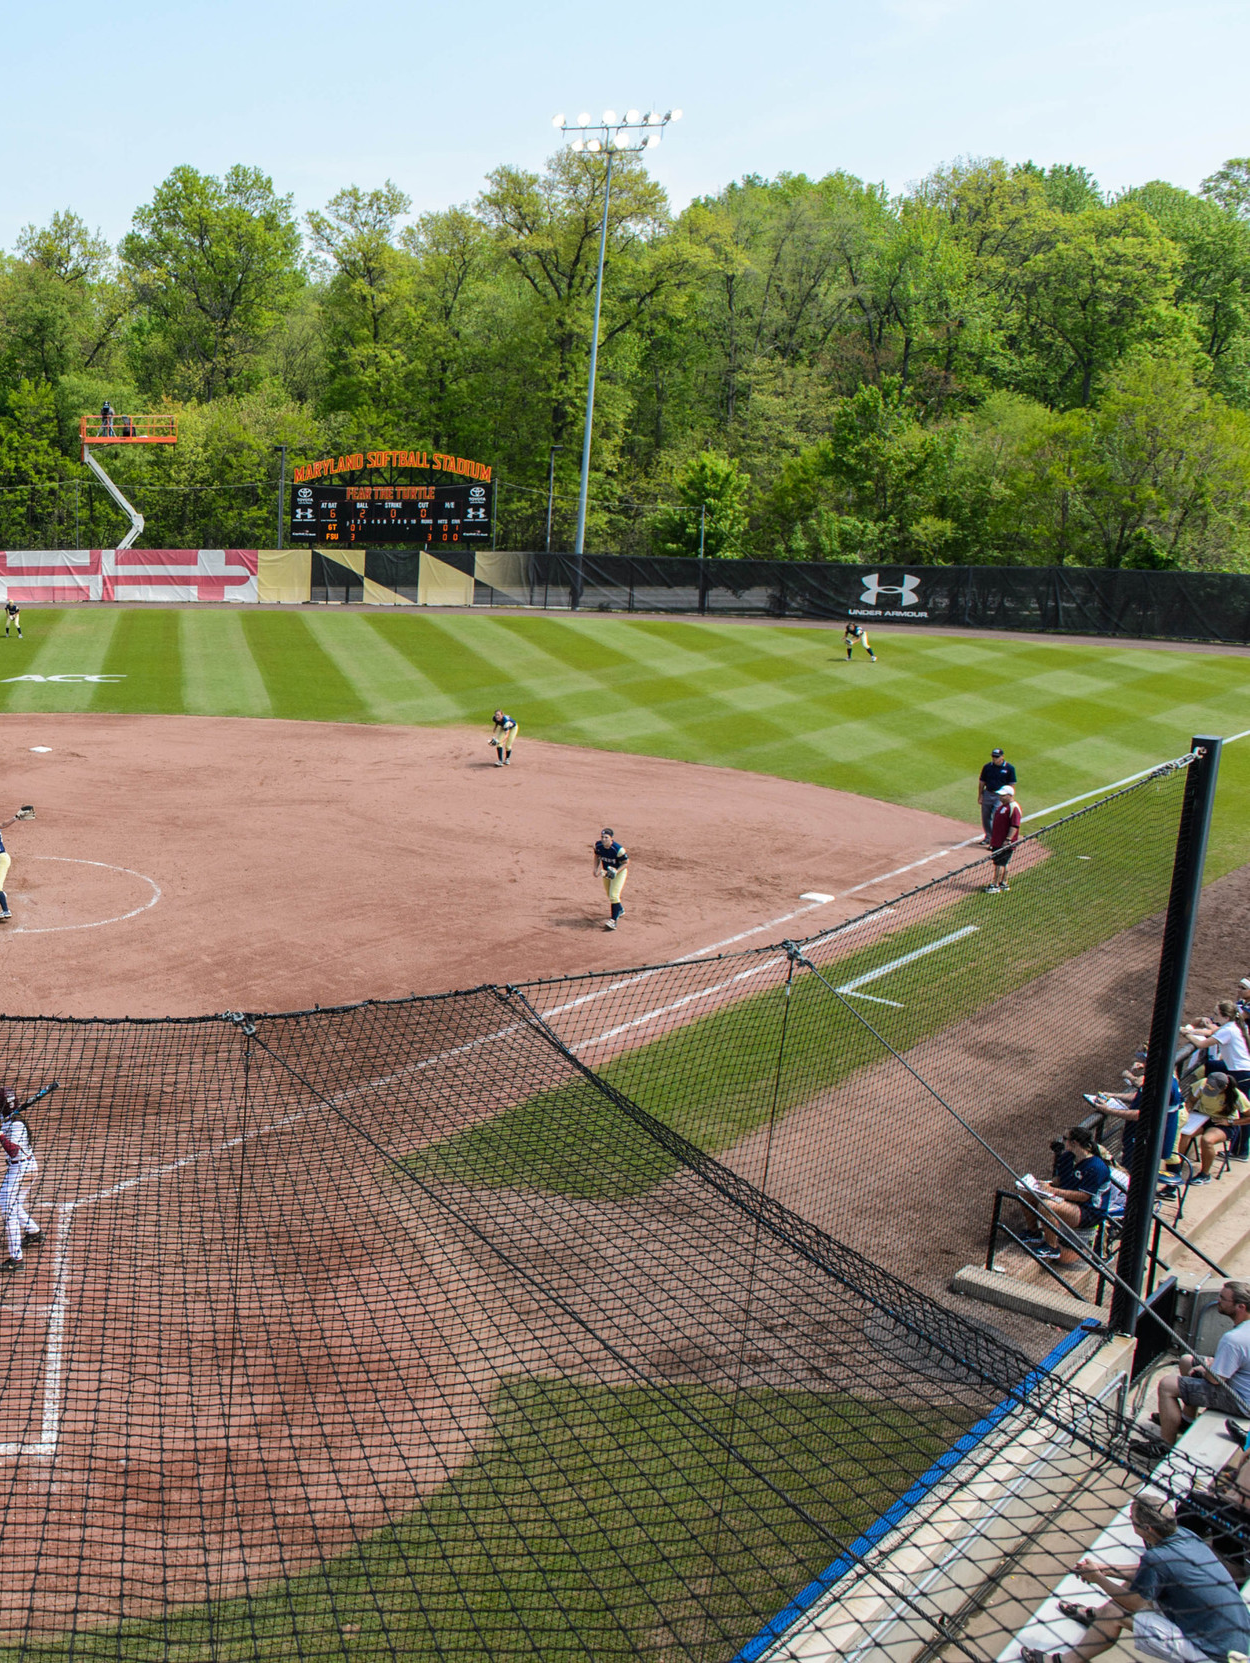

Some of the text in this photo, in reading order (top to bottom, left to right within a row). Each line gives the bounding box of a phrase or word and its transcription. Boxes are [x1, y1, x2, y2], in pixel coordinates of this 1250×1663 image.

[294, 451, 492, 484] MARYLAND SOFTBALL STADIUM
[346, 486, 435, 499] FEAR THE TURTLE
[330, 509, 336, 518] 6
[360, 509, 366, 518] 2
[391, 509, 396, 518] 0
[421, 509, 426, 518] 0
